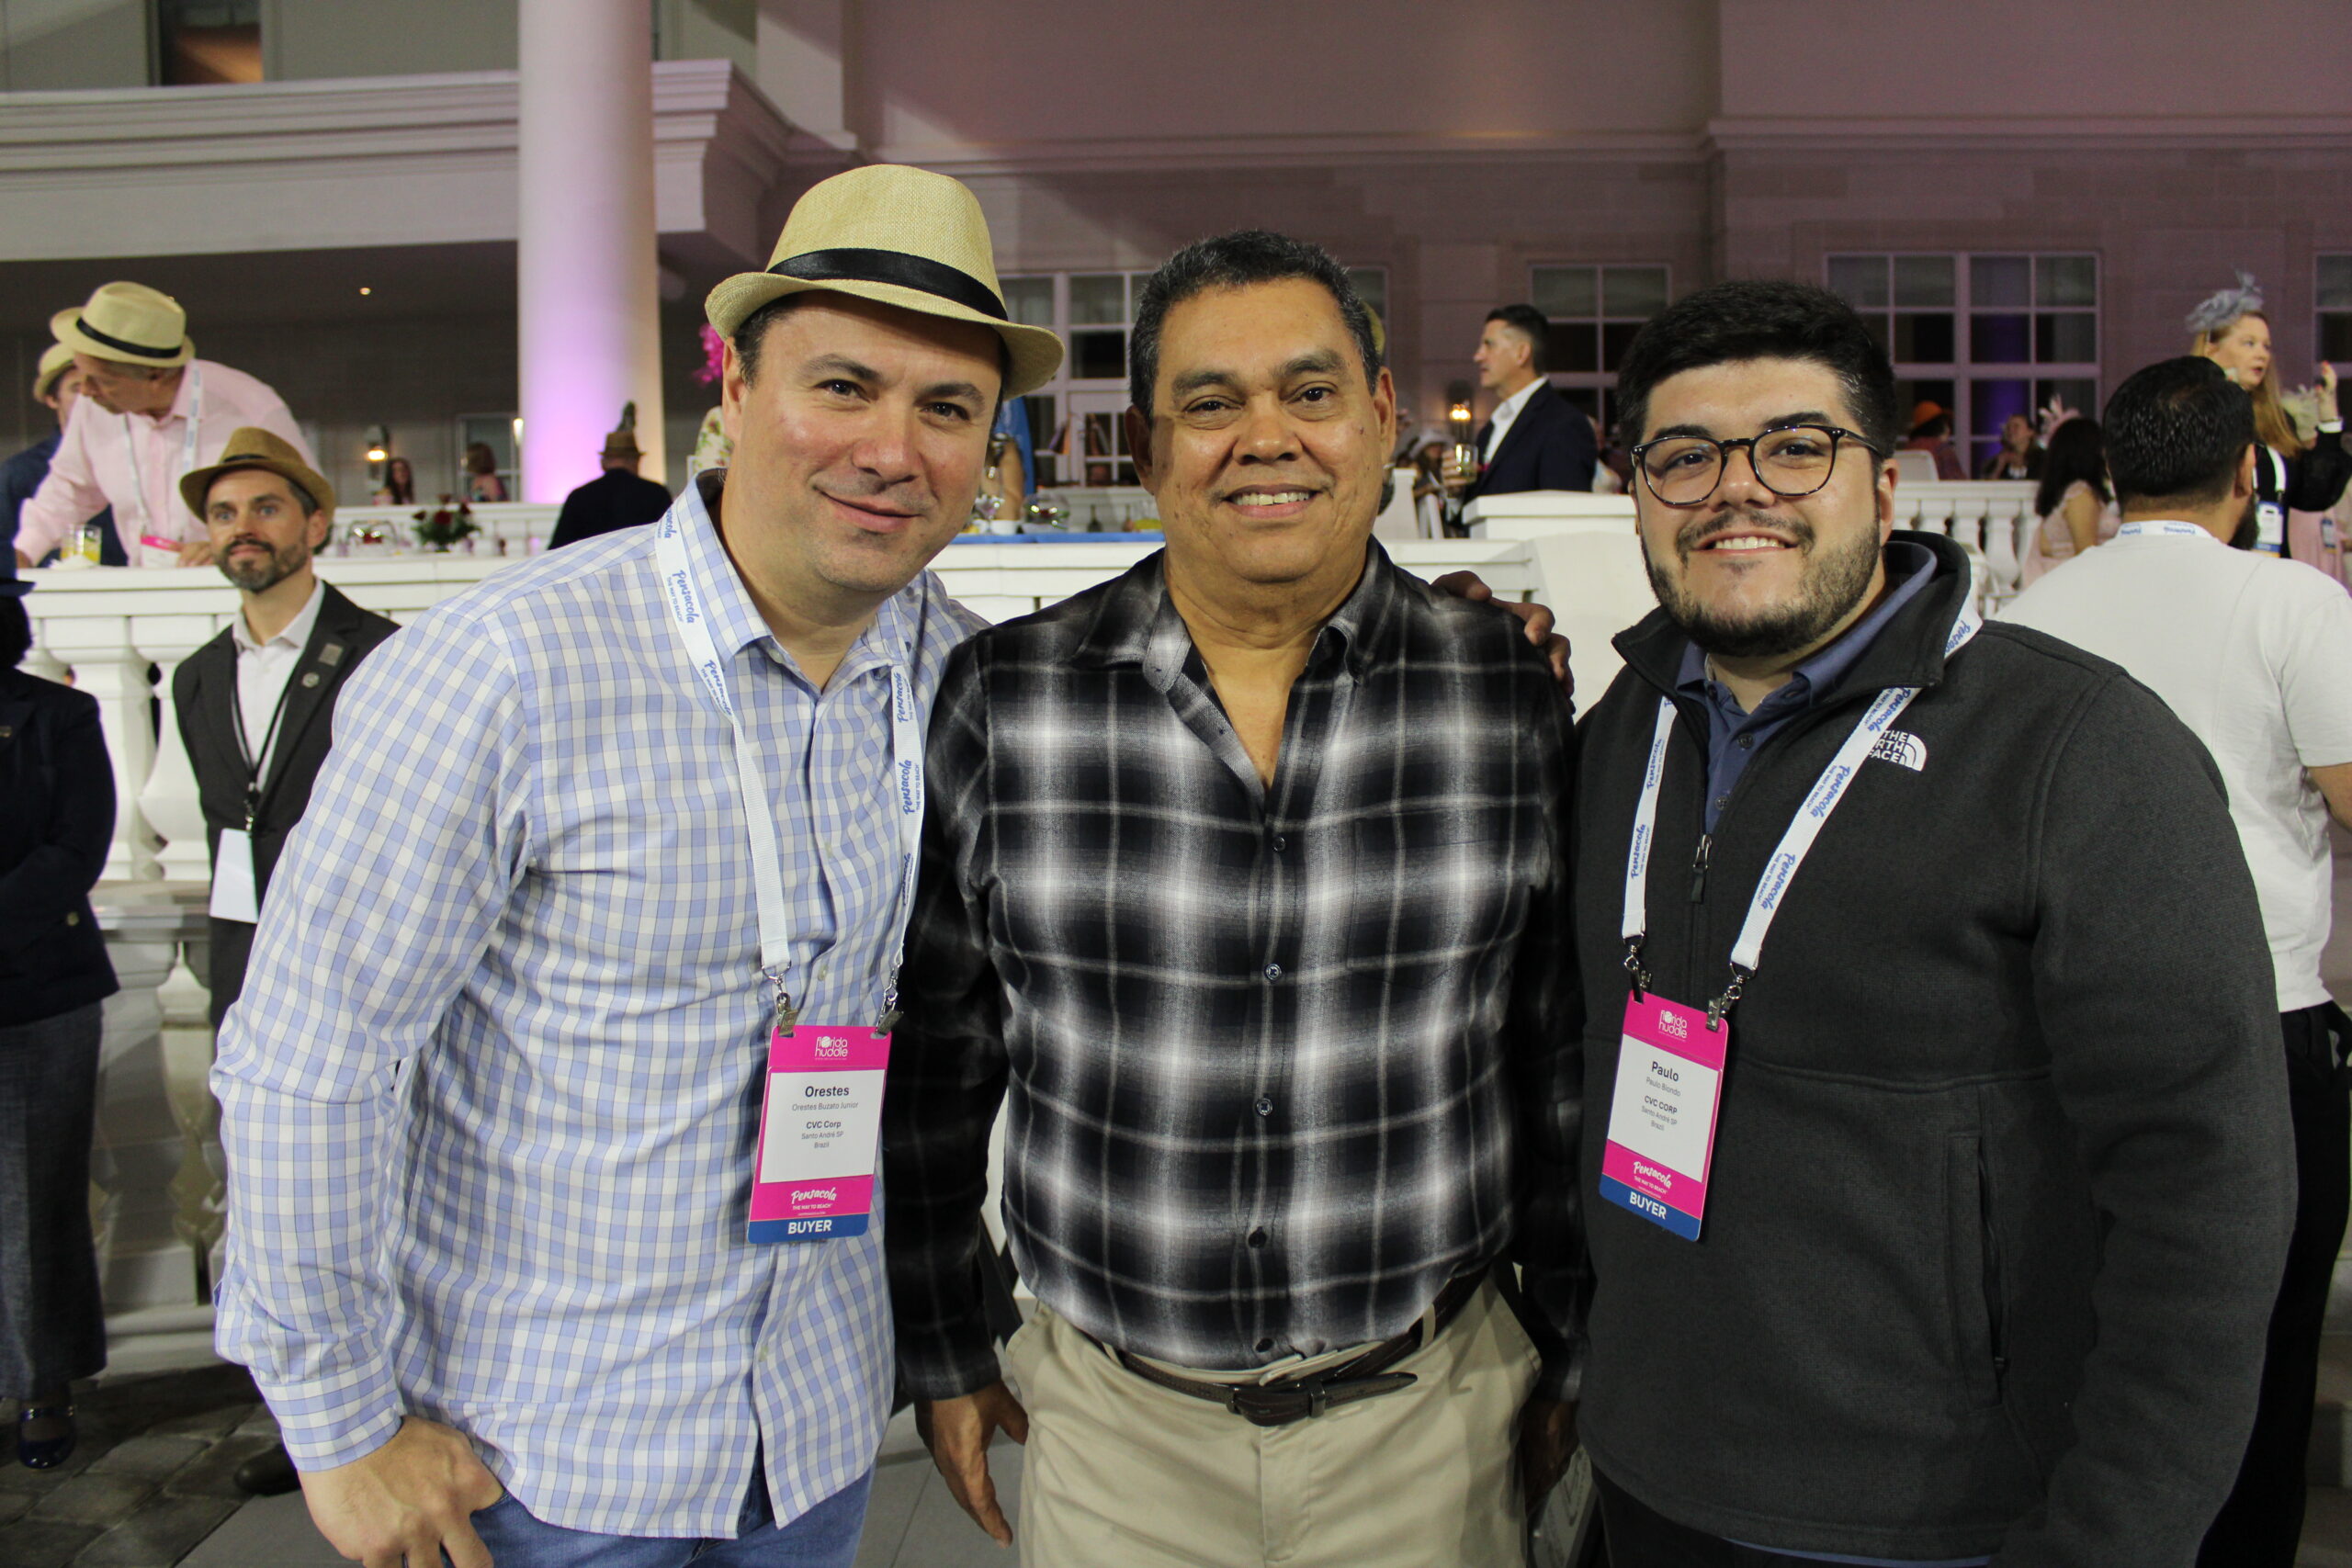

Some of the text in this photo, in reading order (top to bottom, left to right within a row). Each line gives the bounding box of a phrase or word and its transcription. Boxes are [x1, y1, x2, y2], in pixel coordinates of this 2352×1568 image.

[673, 570, 699, 624] Pensacola
[704, 660, 732, 716] Pensacola
[893, 671, 909, 723] Pensacola
[1867, 688, 1911, 732] Pensacola
[1875, 739, 1905, 753] RTH
[1883, 730, 1908, 743] THE
[1646, 739, 1662, 790] Pensacola
[899, 760, 915, 815] Pensacola
[1810, 765, 1850, 818] Pensacola
[1631, 824, 1646, 879] Pensacola
[902, 852, 911, 907] Pensacola
[1761, 853, 1795, 909] Pensacola
[1659, 1010, 1688, 1029] florida
[1658, 1021, 1688, 1038] huddle
[815, 1047, 848, 1057] huddle
[816, 1036, 848, 1049] florida
[1651, 1061, 1679, 1082] Paulo
[805, 1086, 850, 1098] Orestes
[1646, 1077, 1661, 1089] Paulo
[792, 1103, 817, 1111] Orestes
[818, 1102, 840, 1111] Buzato
[1645, 1095, 1678, 1114] CVC CORP
[806, 1120, 842, 1129] CVC Corp
[1651, 1120, 1665, 1131] Brazil
[801, 1132, 819, 1140] Santo
[819, 1131, 835, 1139] André
[1633, 1161, 1672, 1189] Pensacola
[791, 1187, 837, 1204] Pensacola
[1629, 1190, 1667, 1220] BUYER
[787, 1219, 832, 1235] BUYER
